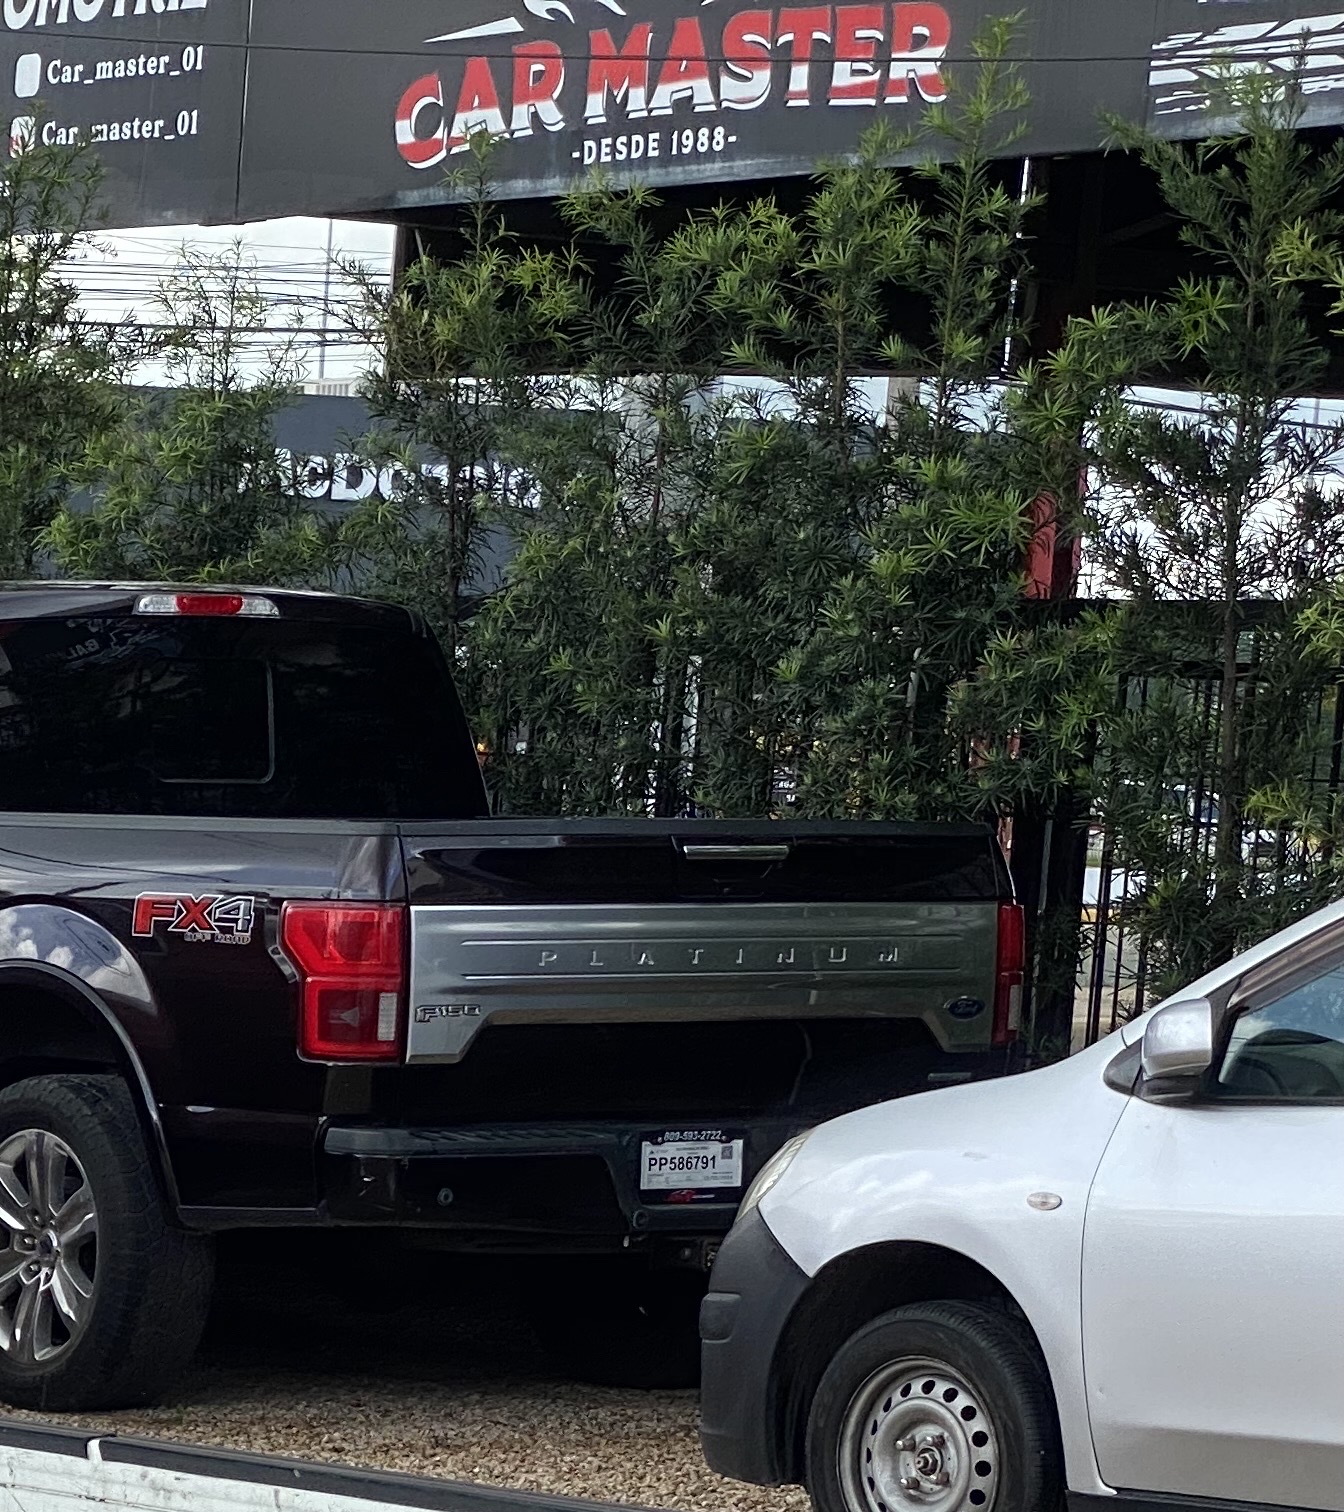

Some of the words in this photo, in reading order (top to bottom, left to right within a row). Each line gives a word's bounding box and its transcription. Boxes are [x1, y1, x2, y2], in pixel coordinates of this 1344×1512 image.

[46, 45, 204, 84] Car_master_01
[395, 41, 564, 169] CAR
[583, 2, 952, 123] MASTER
[132, 892, 255, 937] FX4
[538, 947, 898, 966] PLATINUM
[648, 1155, 716, 1171] PP586791
